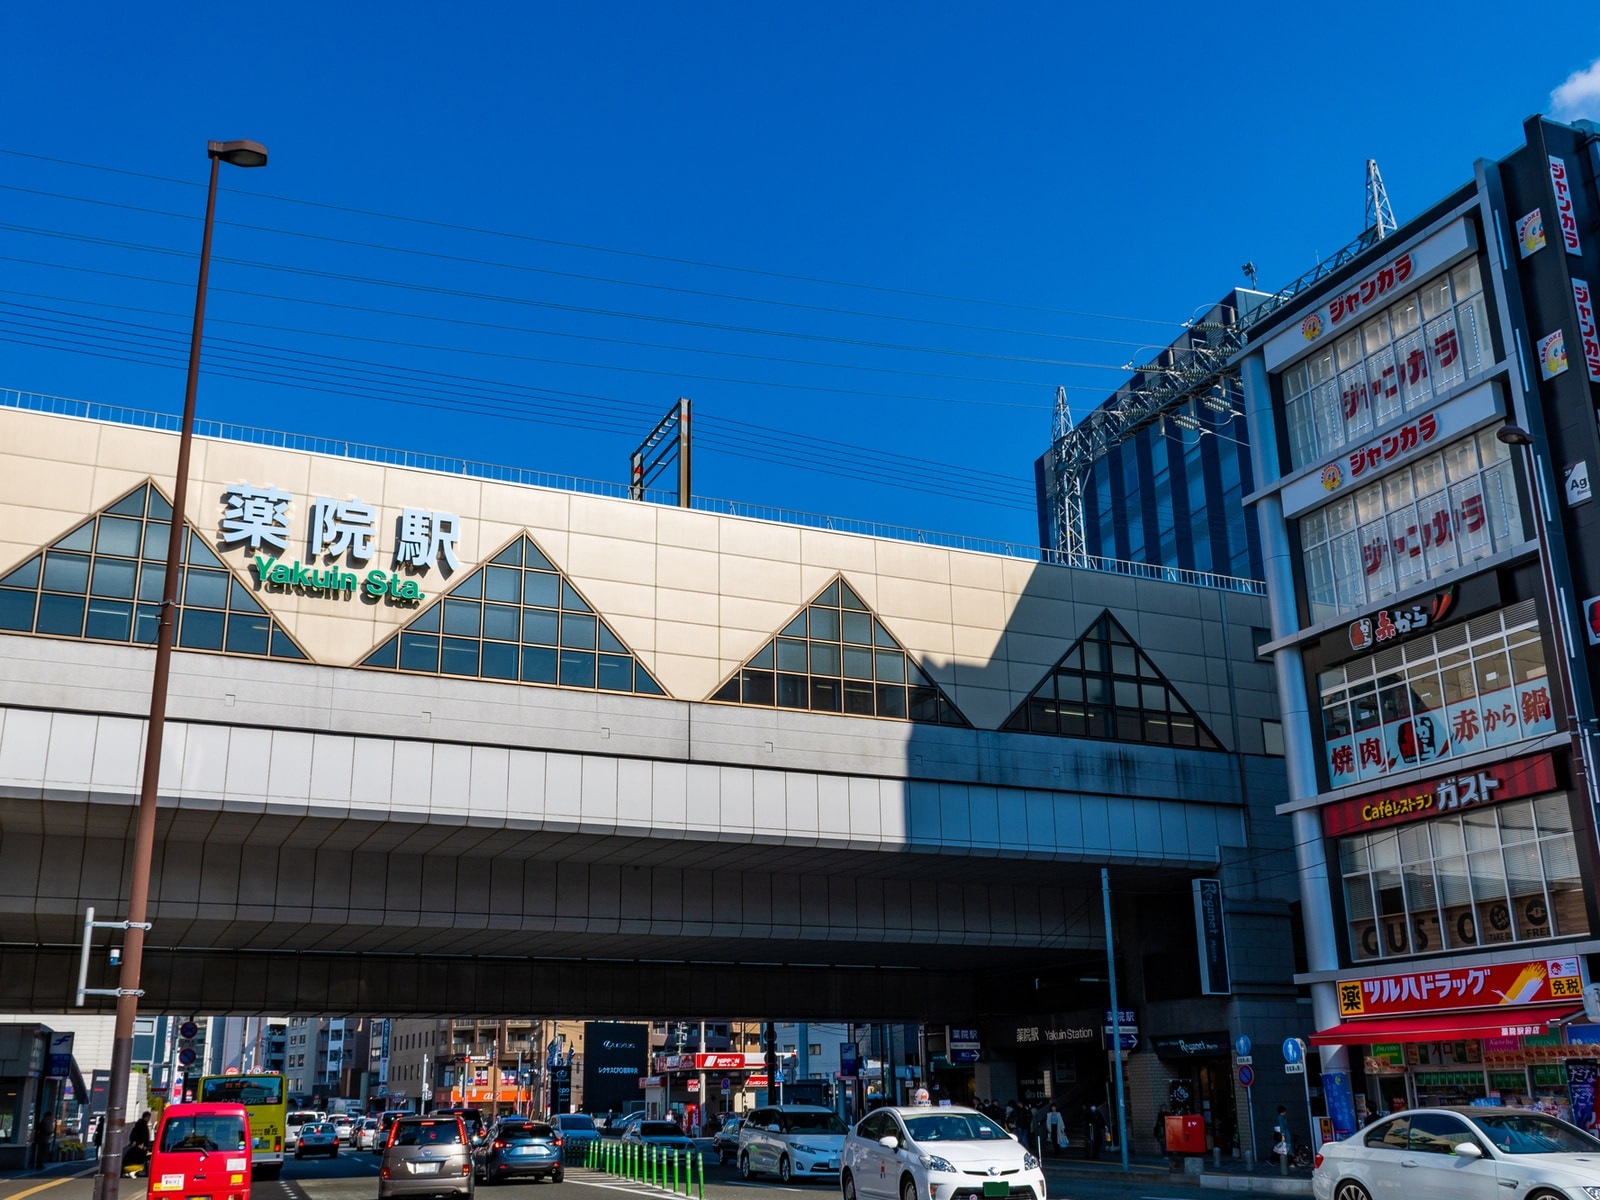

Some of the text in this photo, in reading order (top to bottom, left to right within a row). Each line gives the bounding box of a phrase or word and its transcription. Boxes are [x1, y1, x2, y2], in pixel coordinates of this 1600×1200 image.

[1551, 162, 1579, 249] ジャンカラ
[1519, 211, 1541, 243] KARAOKE
[1329, 254, 1414, 325] ジャンカラ
[1541, 332, 1562, 364] KARAOKE
[1574, 284, 1600, 380] ジャンカラ
[1342, 329, 1459, 421] ジャンカラ
[1349, 413, 1437, 477] ジャンカラ
[1570, 477, 1588, 491] Ag
[222, 482, 460, 572] 薬院駅
[1364, 494, 1486, 576] ジャンカラ
[255, 555, 426, 600] Yakuin Sta.
[1375, 606, 1428, 642] 赤から
[1452, 687, 1552, 745] 赤から鍋
[1331, 738, 1383, 777] 焼肉
[1436, 771, 1501, 812] ガスト
[1342, 985, 1361, 1011] 薬
[1363, 969, 1491, 1004] ツルハドラッグ
[1552, 978, 1580, 995] 免税
[952, 1029, 978, 1040] 薬院駅
[1016, 1027, 1094, 1043] 薬院駅 Yakuin Station
